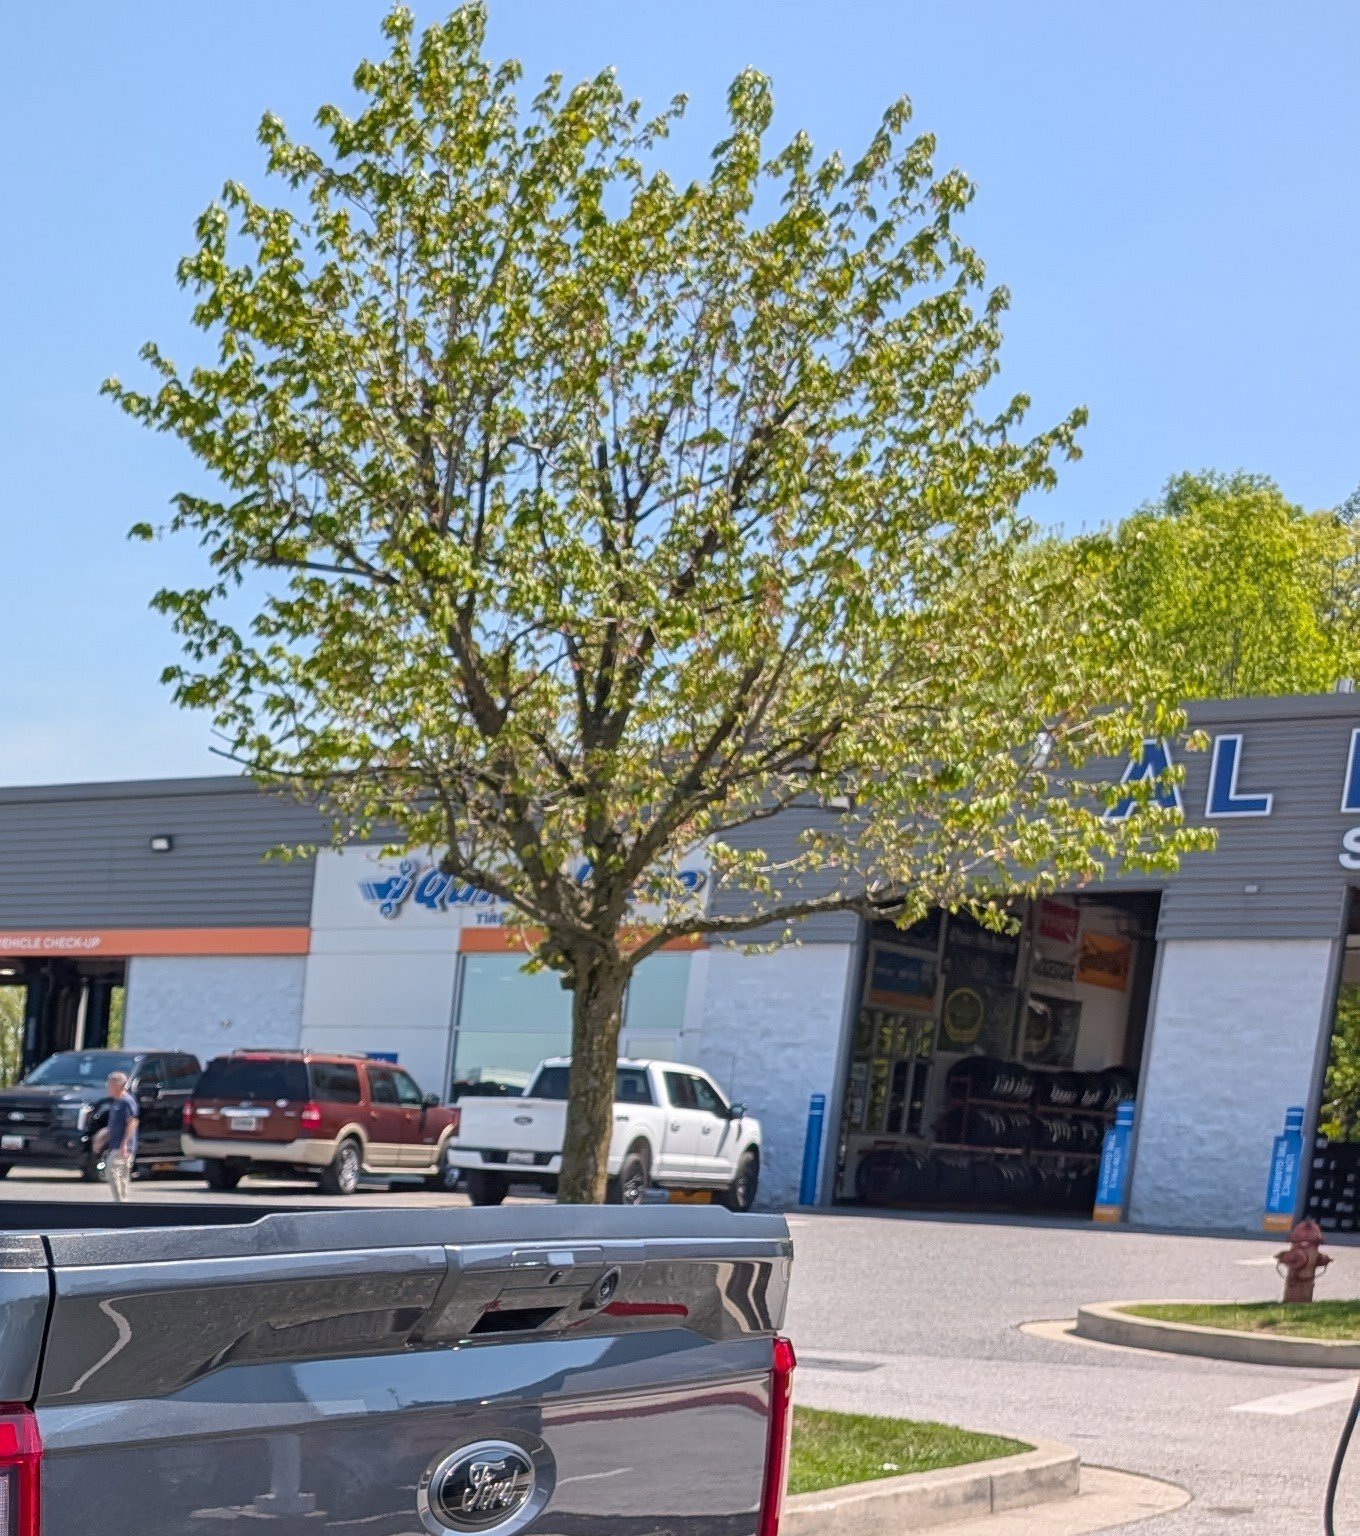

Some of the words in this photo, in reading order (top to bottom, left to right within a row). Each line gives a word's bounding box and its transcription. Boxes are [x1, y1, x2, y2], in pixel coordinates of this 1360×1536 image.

[1103, 734, 1273, 818] AL
[42, 936, 101, 949] CHECK-UP
[460, 1460, 519, 1512] Ford
